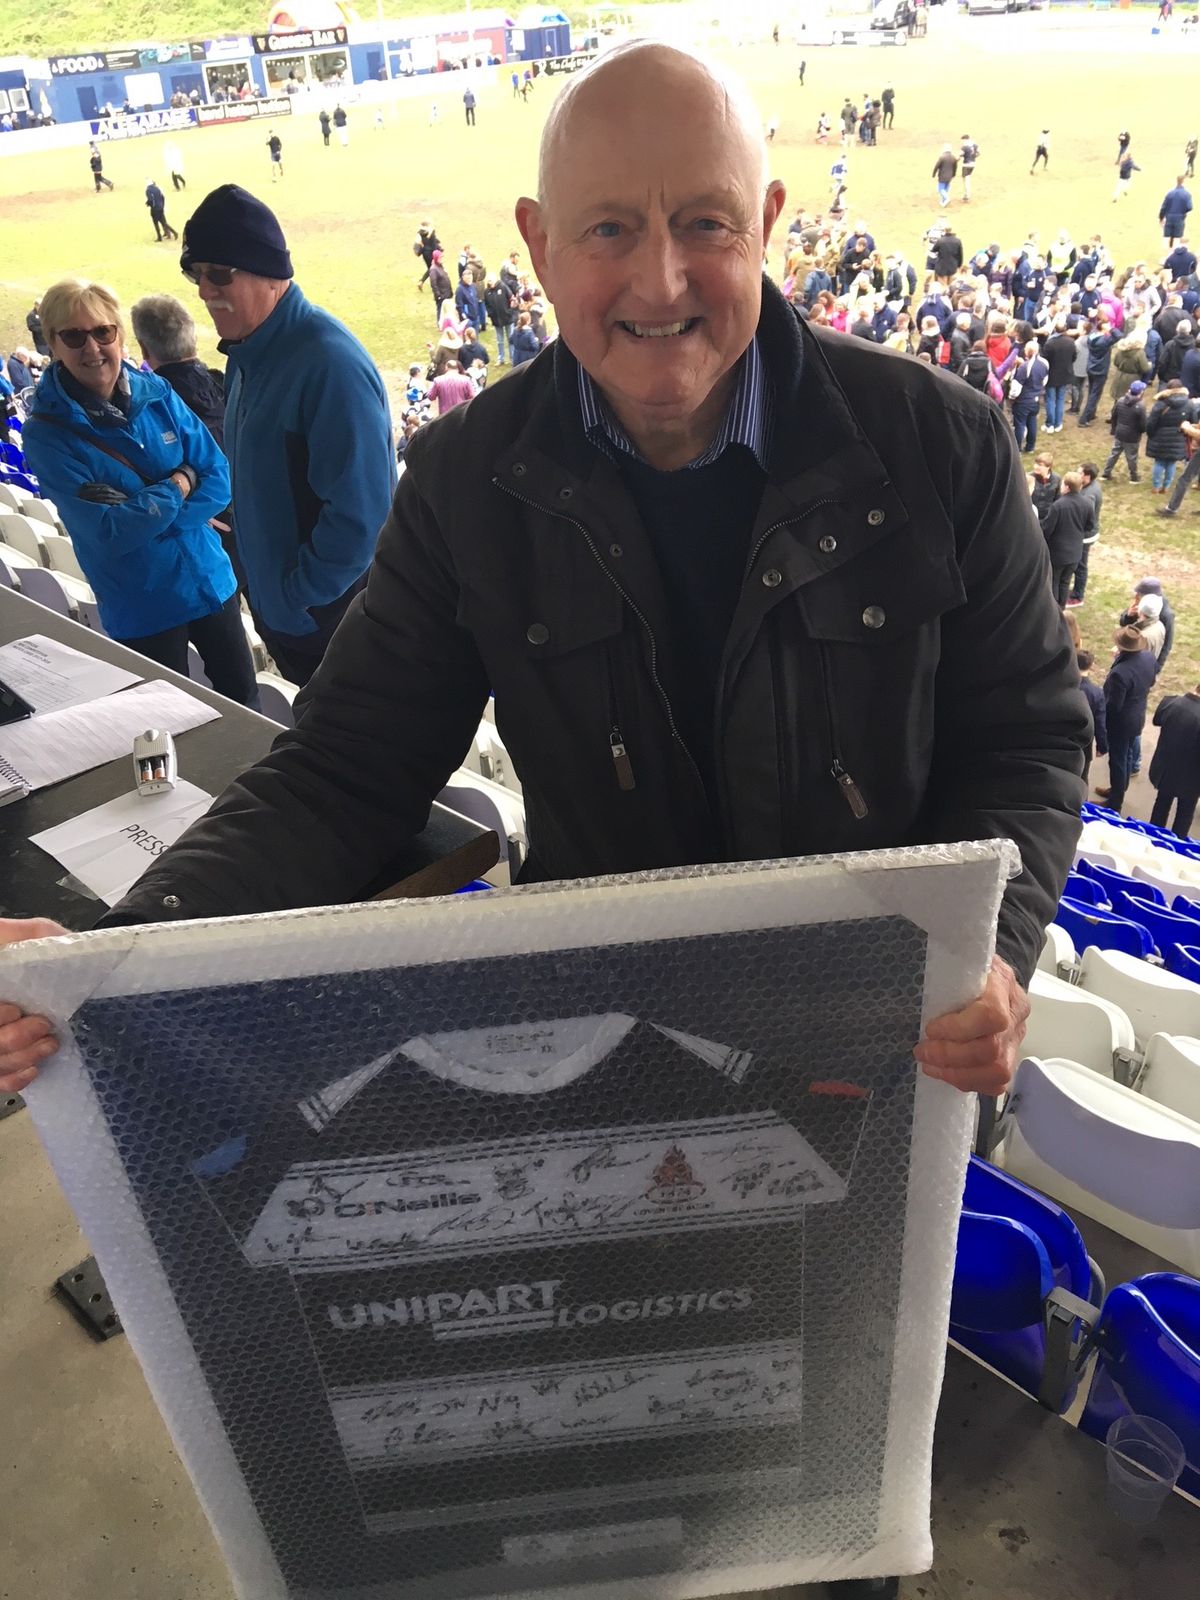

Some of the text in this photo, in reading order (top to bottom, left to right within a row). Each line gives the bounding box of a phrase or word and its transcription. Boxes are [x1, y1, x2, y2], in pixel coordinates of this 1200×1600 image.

[57, 55, 98, 74] FOOD
[120, 823, 169, 856] PRESS
[328, 1280, 753, 1330] UNIPART LOGISTICS
